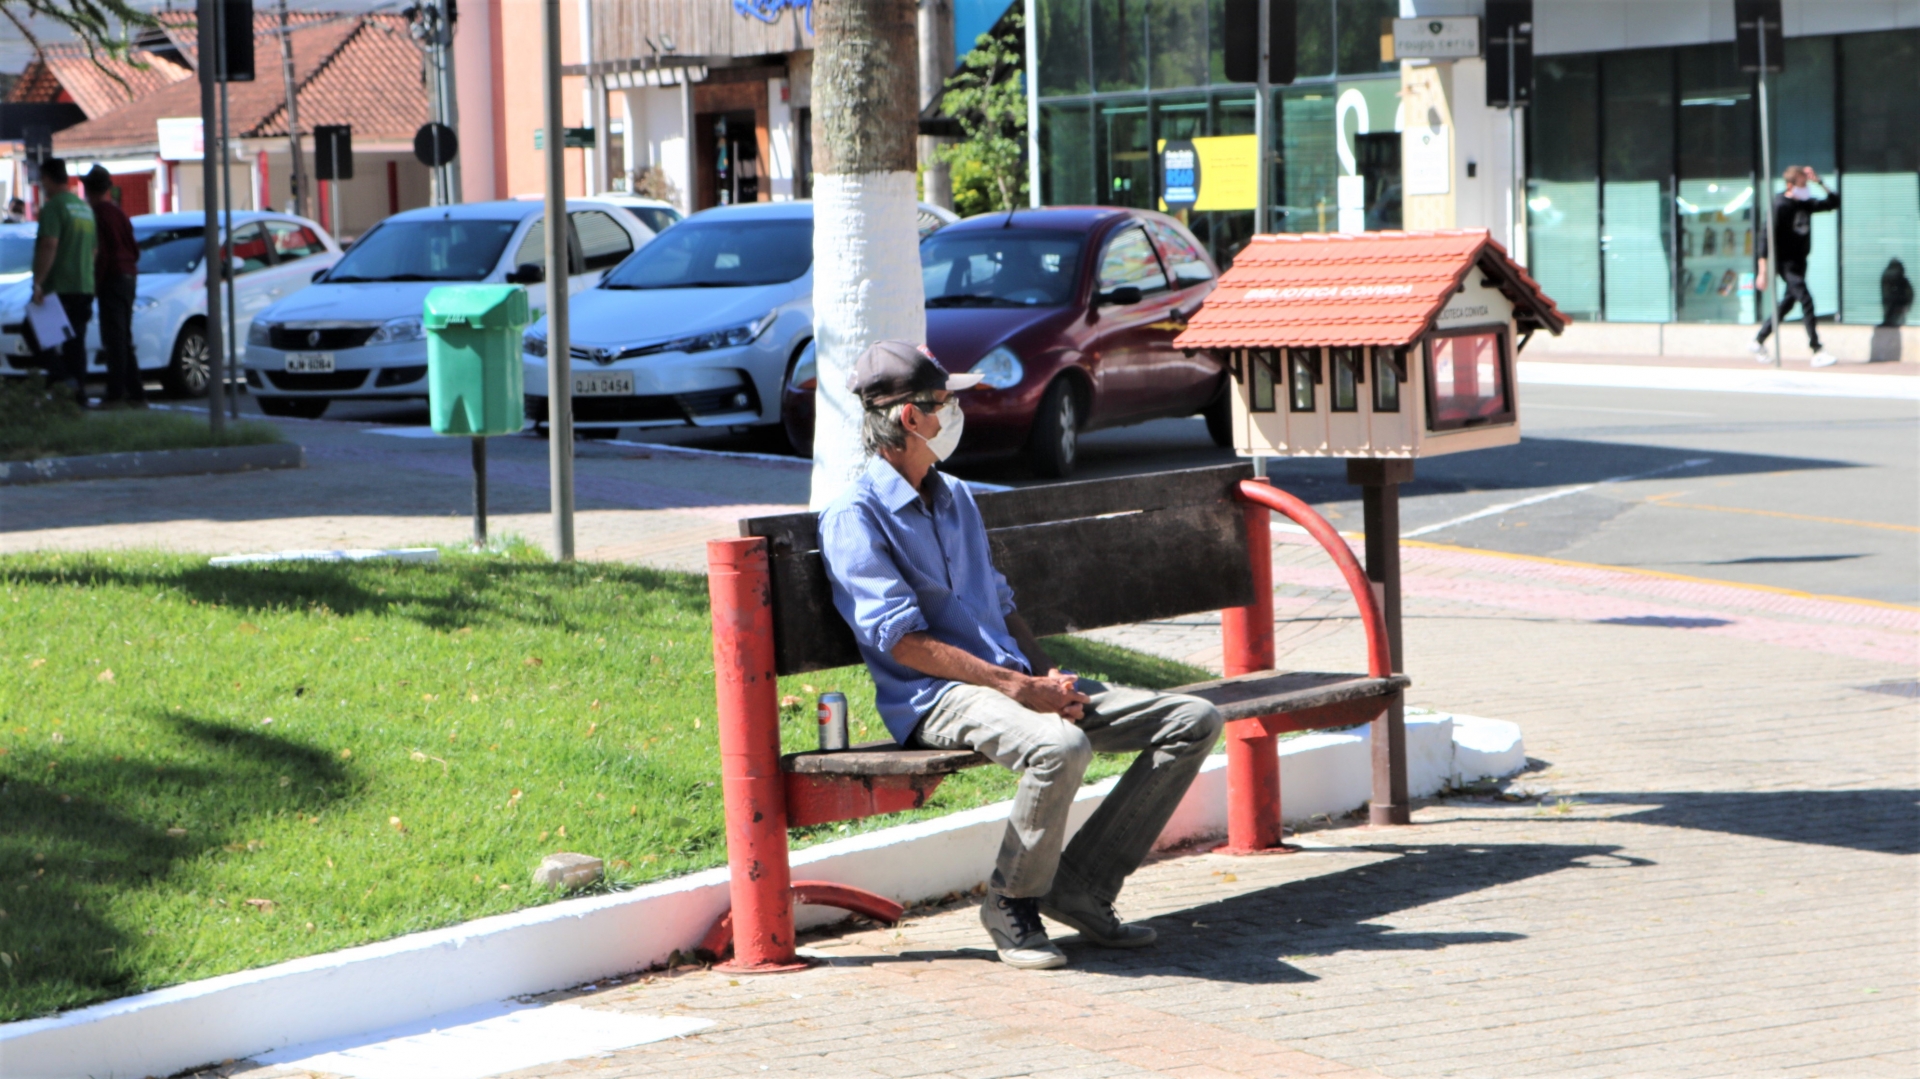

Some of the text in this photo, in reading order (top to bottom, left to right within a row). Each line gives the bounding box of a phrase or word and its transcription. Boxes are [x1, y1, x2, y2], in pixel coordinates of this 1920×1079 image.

[1244, 284, 1413, 299] BIBLIOTECA CONVIDA
[1465, 305, 1489, 318] CONVIDA
